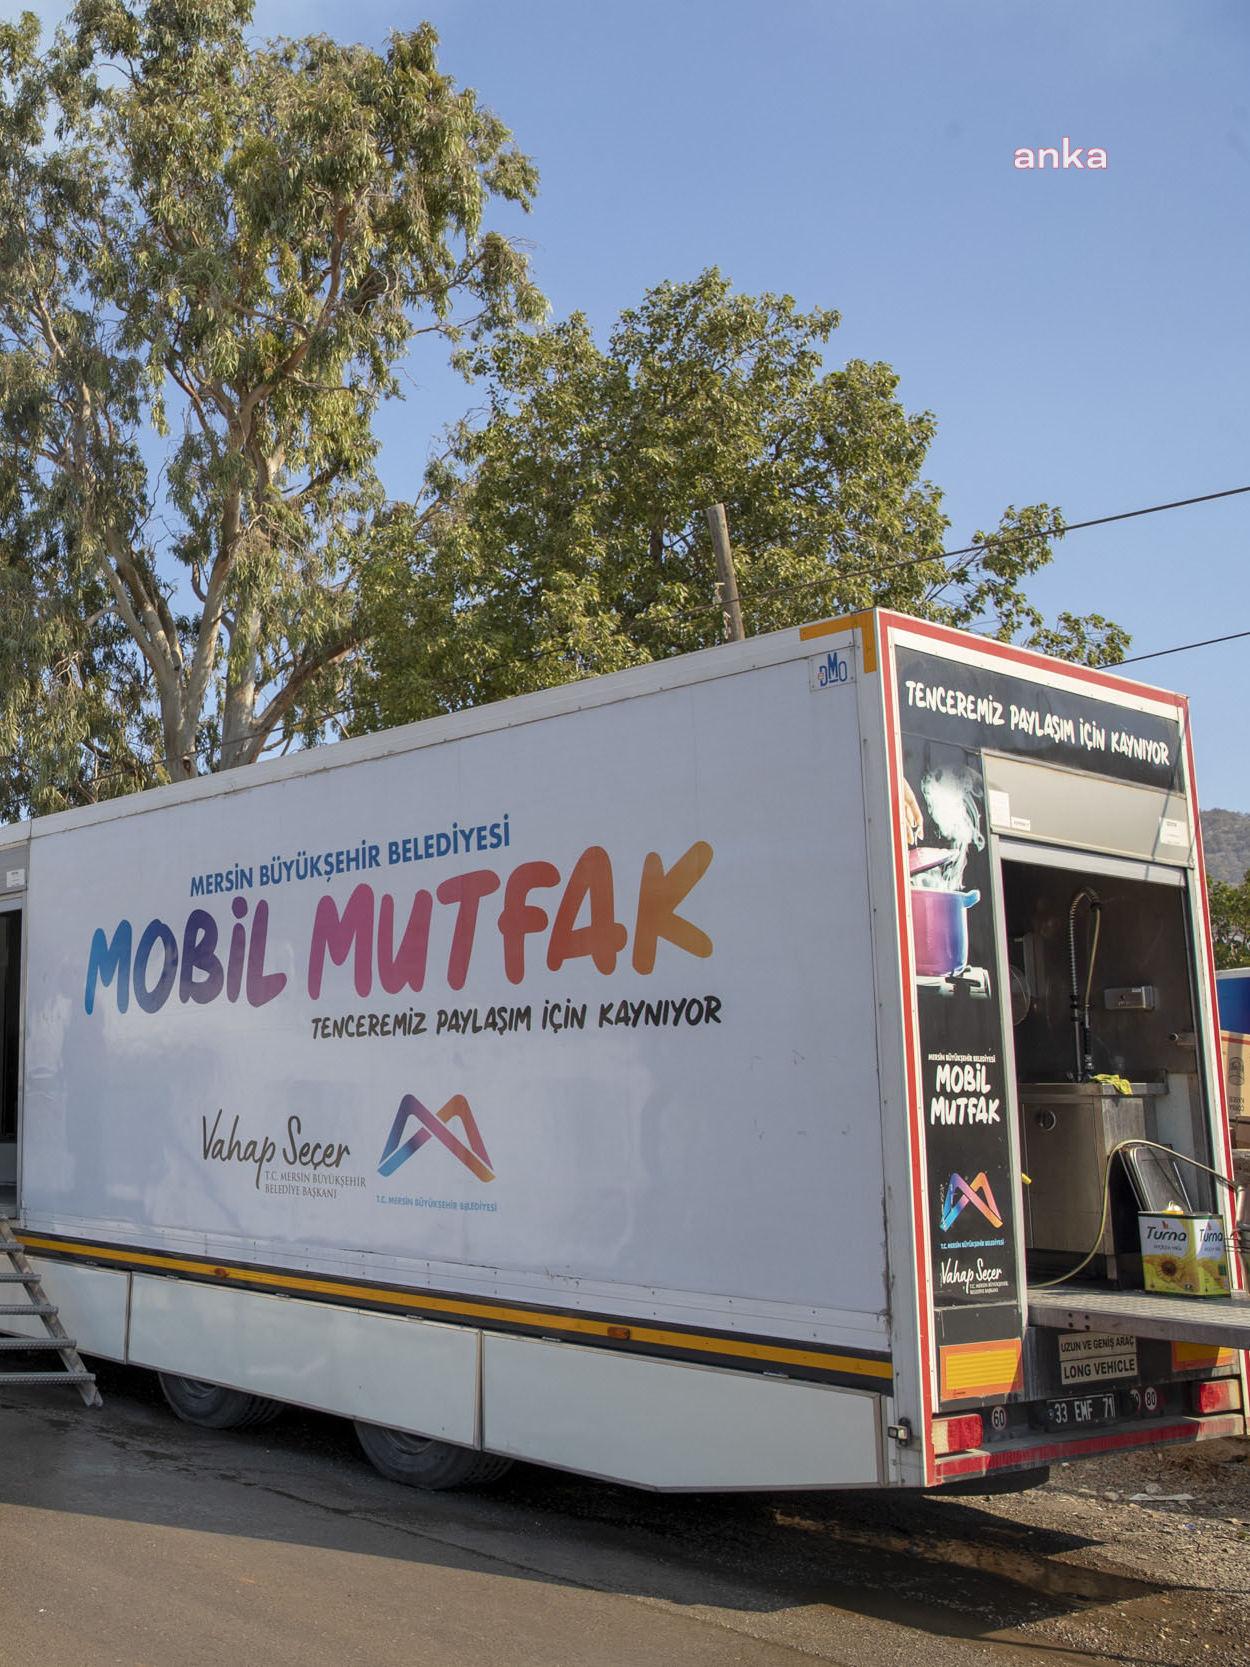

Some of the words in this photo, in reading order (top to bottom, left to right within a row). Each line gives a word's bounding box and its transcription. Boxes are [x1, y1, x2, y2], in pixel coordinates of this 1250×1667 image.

[906, 680, 1005, 726] TENCEREMİZ
[1010, 704, 1075, 744] PAYLAŞIM
[1079, 718, 1105, 751] İÇİN
[1111, 731, 1170, 766] KAYNIYOR
[190, 863, 253, 897] MERSİN
[260, 839, 381, 883] BÜYÜKŞEHİR
[388, 813, 510, 865] BELEDİYESİ
[84, 896, 287, 1015] MOBİL
[307, 841, 715, 1000] MUTFAK
[312, 1007, 428, 1040] TENCEREMİZ
[436, 1005, 532, 1036] PAYLAŞIM
[542, 998, 587, 1034] İÇİN
[598, 995, 722, 1028] KAYNIYOR
[936, 1063, 991, 1094] MOBİL
[931, 1096, 1000, 1125] MUTFAK
[203, 1109, 276, 1190] Vahap
[282, 1115, 350, 1170] Seçer
[265, 1183, 300, 1195] BELEDİYE
[302, 1186, 337, 1199] BAŞKANI
[280, 1171, 311, 1183] MERSİN
[312, 1174, 366, 1187] BÜYÜKŞEHİR
[388, 1195, 413, 1206] MERSİN
[1147, 1226, 1187, 1241] Turna
[1199, 1229, 1223, 1242] Turna
[941, 1258, 974, 1294] Vahap
[976, 1258, 1002, 1281] Seçer
[1061, 1340, 1081, 1353] UZUN
[1082, 1339, 1092, 1350] VE
[1094, 1336, 1114, 1349] GENİŞ
[1116, 1336, 1134, 1348] ARAÇ
[1063, 1363, 1091, 1379] LONG
[1094, 1358, 1135, 1375] VEHICLE
[1054, 1402, 1068, 1424] 33
[1102, 1397, 1114, 1418] 71
[1146, 1389, 1157, 1410] 80
[993, 1408, 1006, 1428] 60
